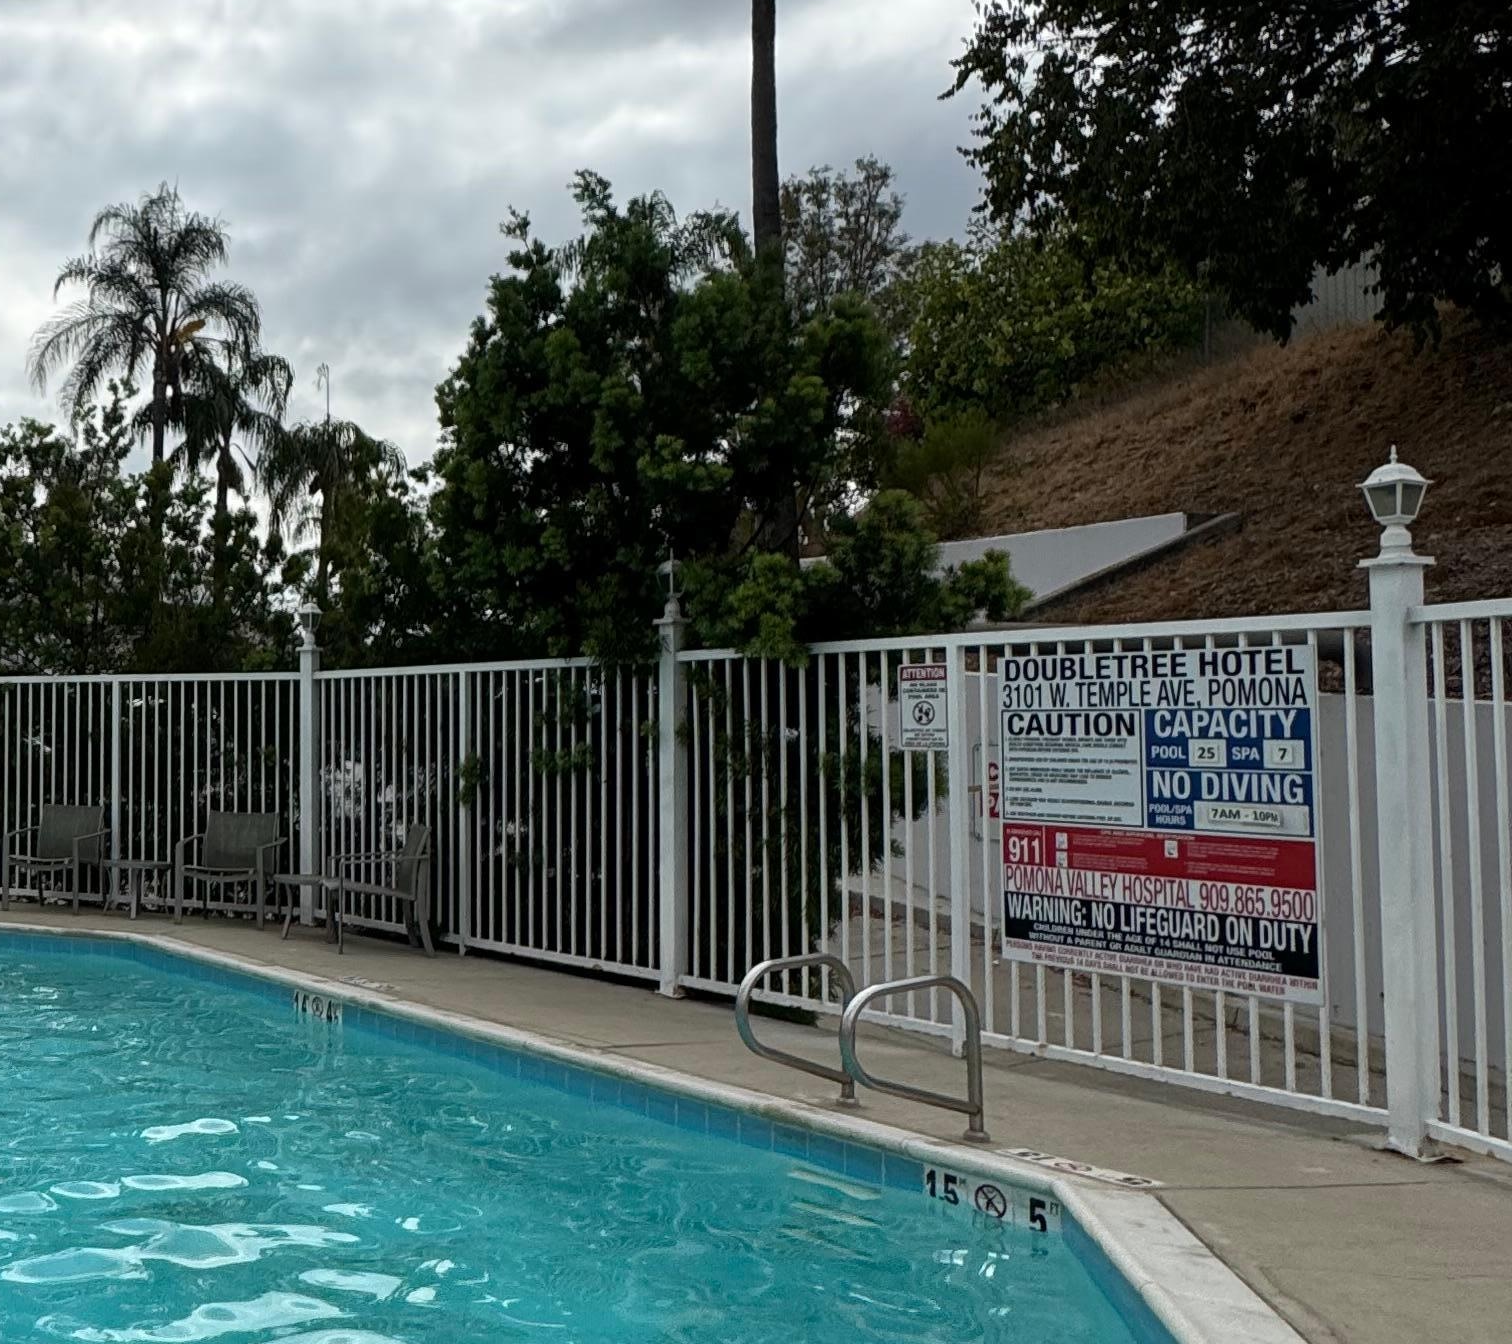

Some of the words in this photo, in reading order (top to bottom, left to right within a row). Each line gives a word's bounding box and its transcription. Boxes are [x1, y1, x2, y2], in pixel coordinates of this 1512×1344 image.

[902, 668, 945, 679] ATTENTION
[1004, 653, 1187, 682] DOUBLETREE
[1199, 649, 1305, 677] HOTEL
[1002, 683, 1042, 709] 3101
[1049, 683, 1070, 708] W.
[1075, 679, 1151, 708] TEMPLE
[1209, 676, 1308, 707] POMONA
[1007, 712, 1135, 737] CAUTION
[1153, 709, 1297, 739] CAPACITY
[1151, 745, 1186, 759] POOL
[1197, 746, 1216, 760] 25
[1231, 746, 1260, 761] SPA
[1278, 748, 1288, 760] 7
[1152, 771, 1191, 799] NO
[1201, 772, 1304, 803] DIVING
[1149, 803, 1194, 815] POOL/SPA
[1210, 808, 1241, 820] 7AM
[1252, 811, 1279, 823] 10PM
[1156, 814, 1186, 825] HOURS
[1008, 836, 1040, 864] 911
[1006, 865, 1064, 897] POMONA
[1065, 870, 1118, 902] VALLEY
[1122, 877, 1195, 909] HOSPITAL
[1199, 882, 1315, 921] 909.865.9500
[1007, 893, 1087, 927] WARNING:
[1091, 902, 1114, 929] NO
[1120, 906, 1220, 943] LIFEGUARD
[1226, 915, 1254, 947] ON
[1260, 919, 1313, 954] DUTY
[1033, 922, 1074, 935] CHILDREN
[1107, 931, 1123, 941] THE
[1145, 936, 1157, 945] OF
[1172, 940, 1203, 952] SHALL
[1204, 943, 1224, 954] NOT
[1226, 946, 1246, 956] USE
[1248, 949, 1275, 961] POOL
[1075, 938, 1108, 949] PARENT
[1154, 948, 1203, 961] GUARDIAN
[1204, 953, 1215, 963] IN
[1217, 955, 1283, 972] ATTENDANCE
[1028, 1196, 1048, 1233] 5
